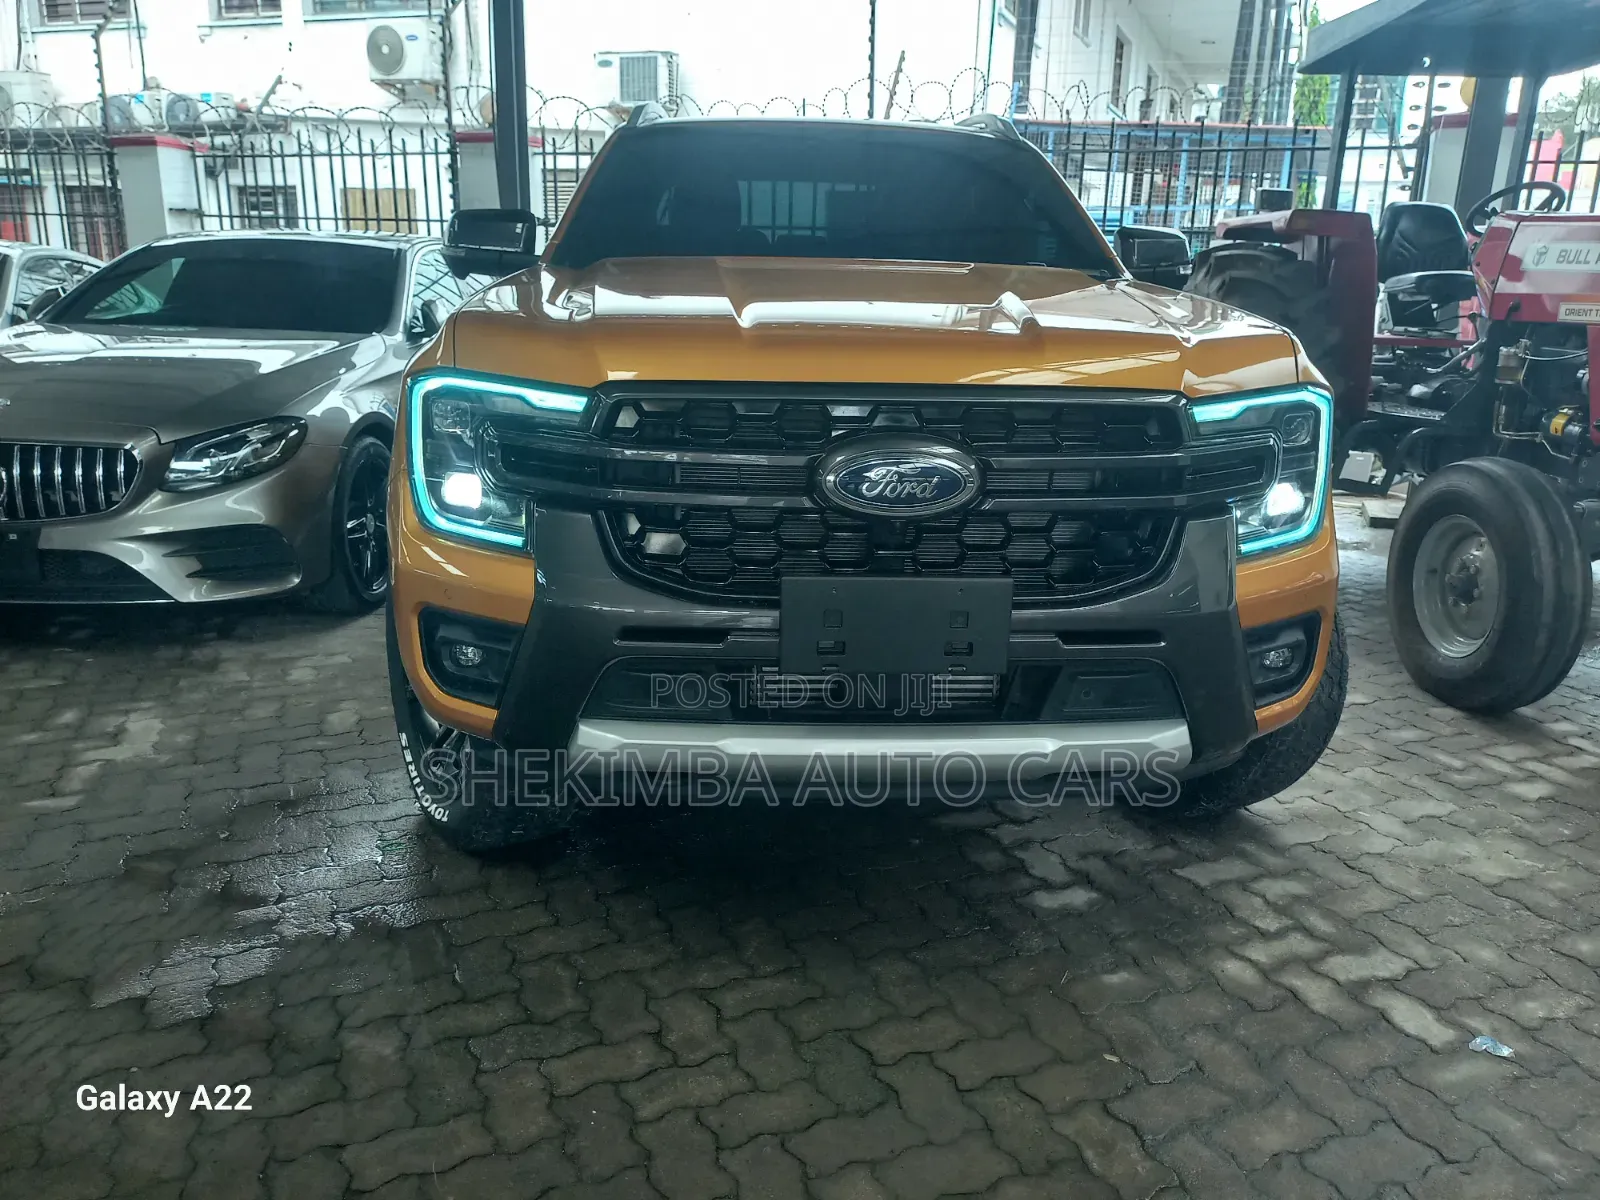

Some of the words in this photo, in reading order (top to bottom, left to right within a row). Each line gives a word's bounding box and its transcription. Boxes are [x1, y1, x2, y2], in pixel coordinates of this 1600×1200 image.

[1556, 249, 1590, 265] BULL
[1564, 308, 1593, 317] ORIENT
[862, 464, 941, 498] Ford
[399, 732, 425, 797] TIRES
[421, 794, 450, 822] TOYO
